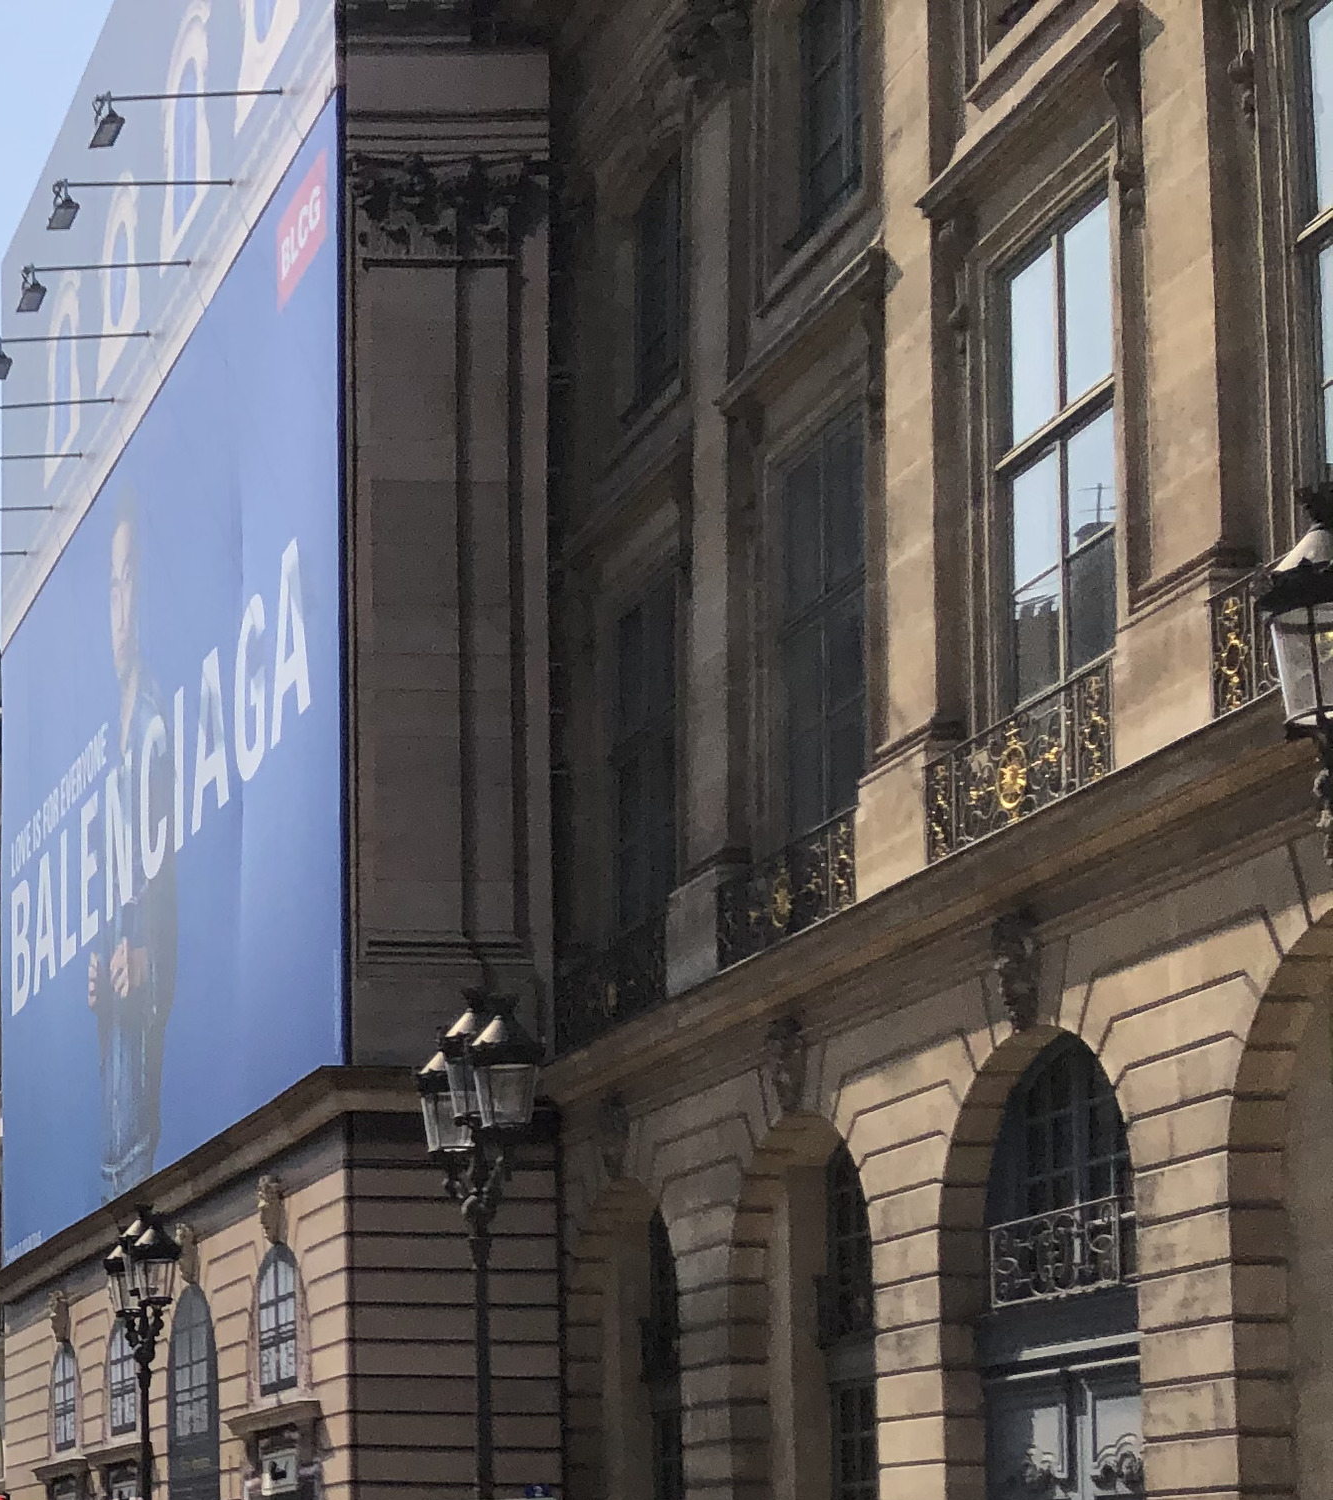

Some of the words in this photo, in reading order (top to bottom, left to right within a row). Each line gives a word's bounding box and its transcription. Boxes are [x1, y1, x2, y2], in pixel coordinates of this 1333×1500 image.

[281, 185, 321, 281] BLCG
[11, 537, 311, 1017] BALENCIAGA
[11, 820, 31, 878] LOVE
[33, 809, 41, 852] IS
[42, 787, 59, 840] FOR
[60, 722, 109, 817] EVERYONE
